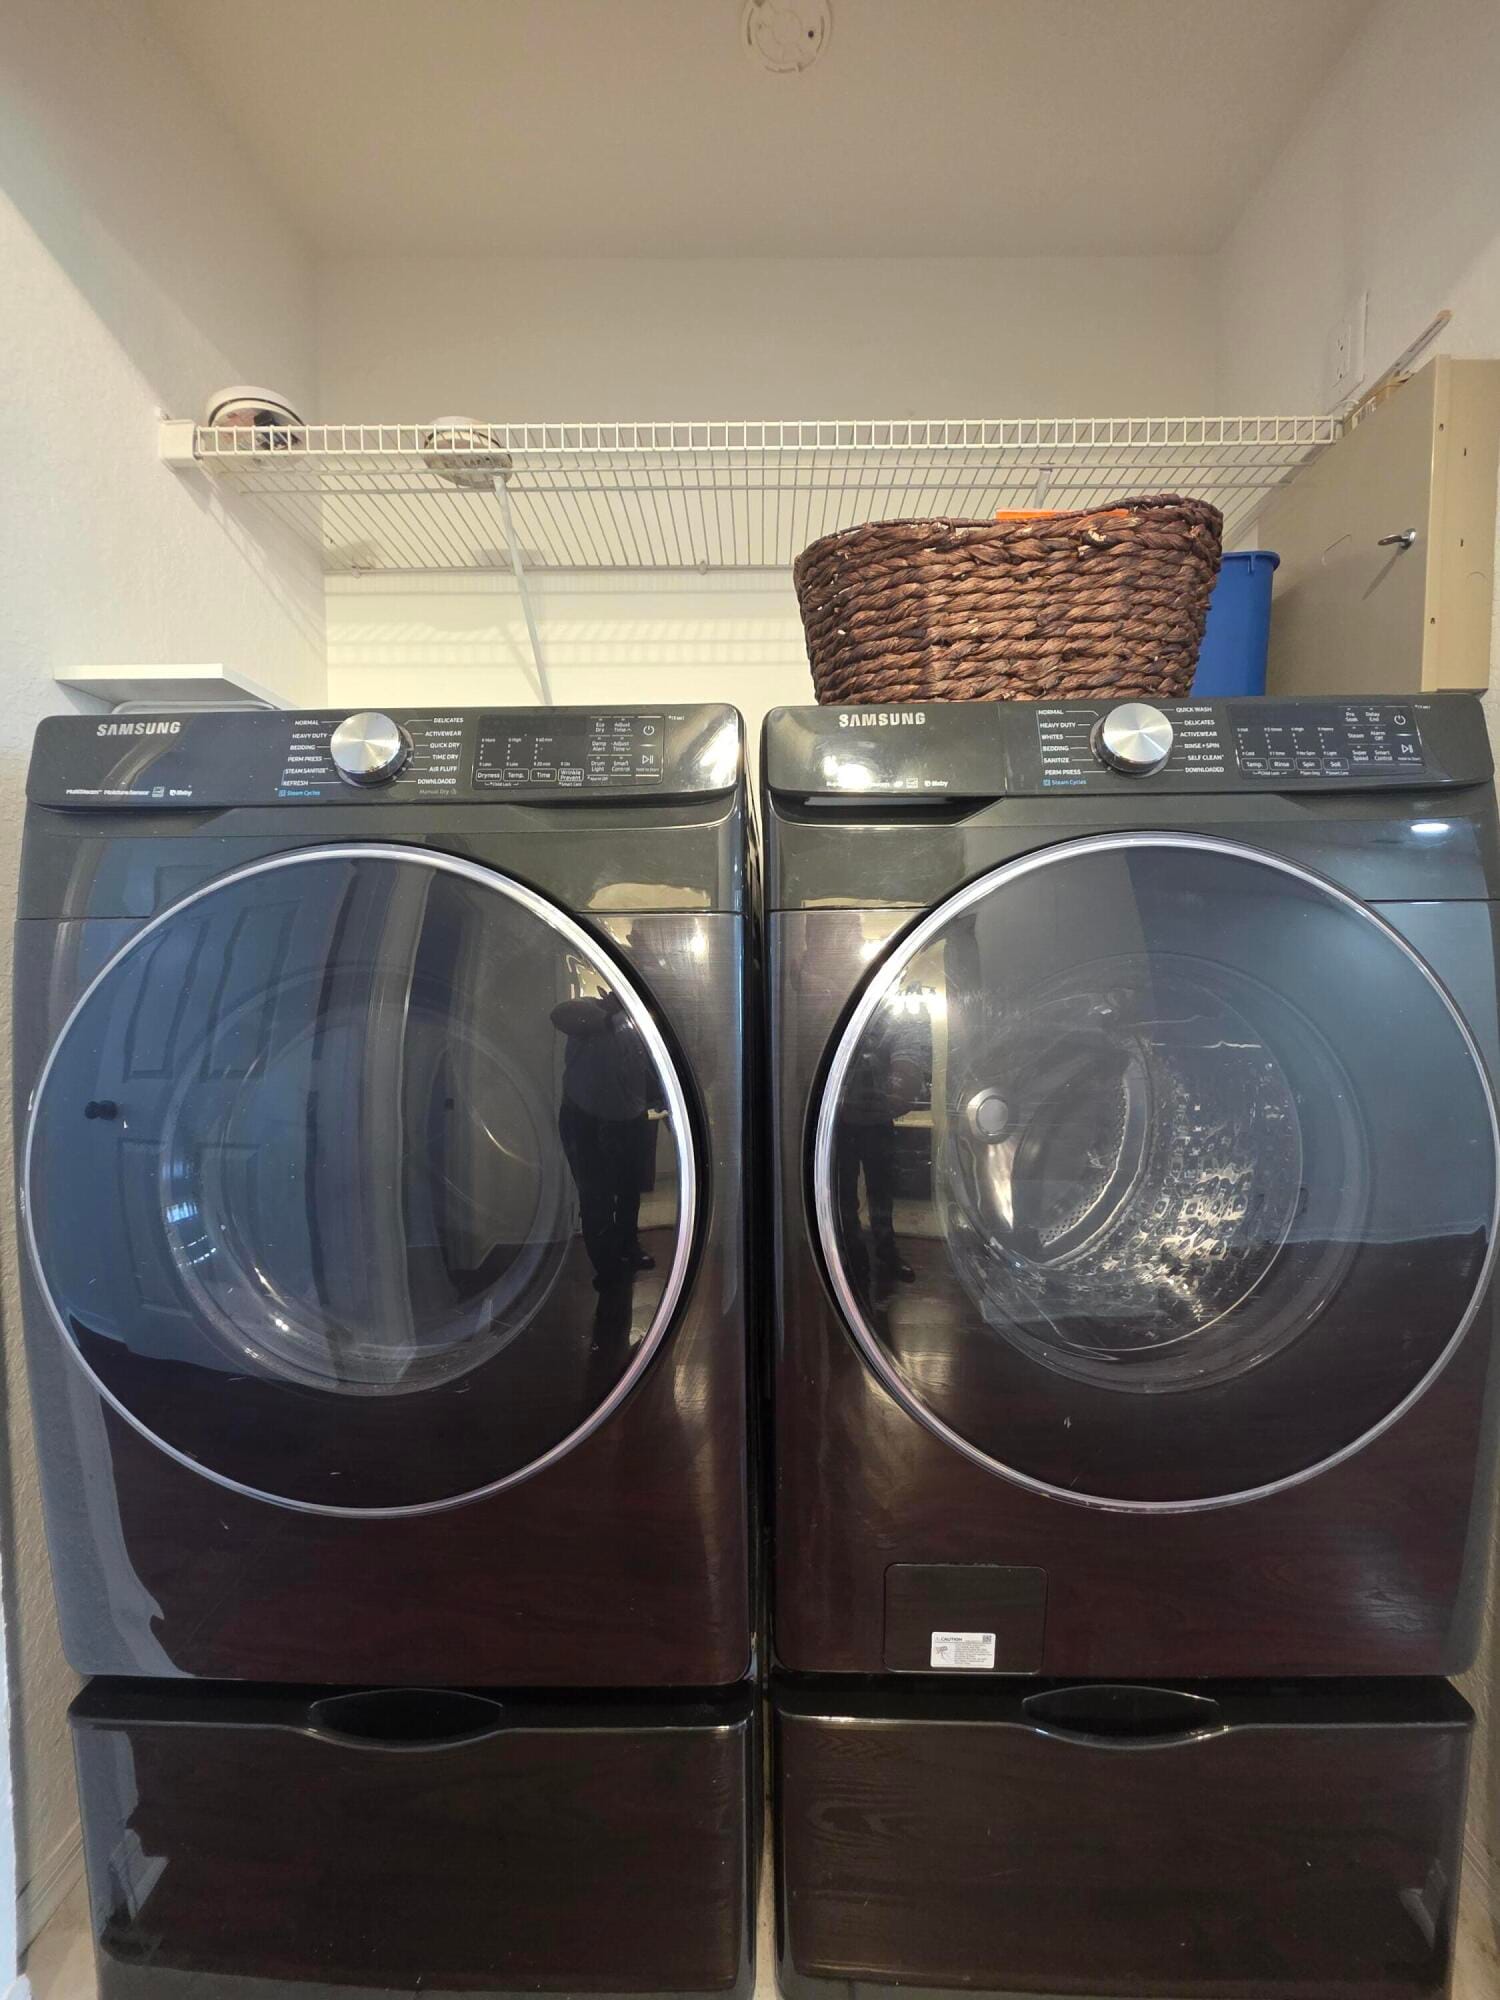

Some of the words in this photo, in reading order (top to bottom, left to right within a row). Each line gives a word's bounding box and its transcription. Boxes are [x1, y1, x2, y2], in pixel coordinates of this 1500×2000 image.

[839, 712, 926, 728] SAMSUNG
[96, 721, 181, 736] SAMSUNG
[1302, 761, 1316, 769] Spin
[477, 772, 501, 780] Dryness
